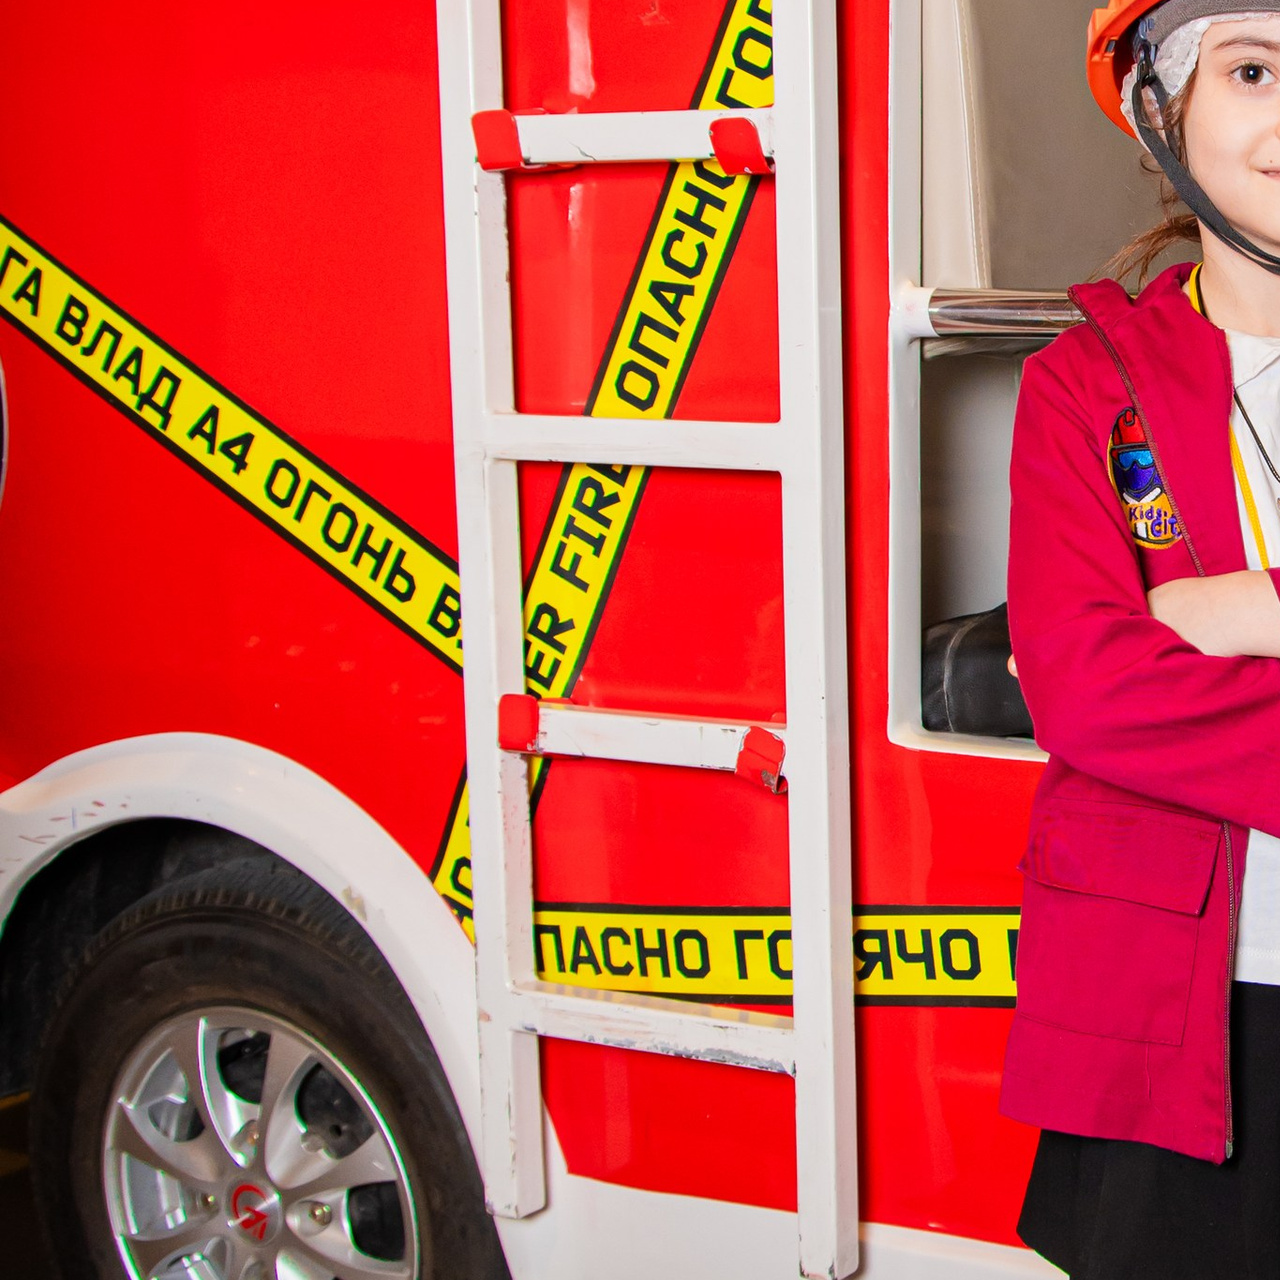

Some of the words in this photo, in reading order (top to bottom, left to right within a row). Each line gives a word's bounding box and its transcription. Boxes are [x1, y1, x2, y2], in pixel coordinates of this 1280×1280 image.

[54, 293, 183, 432] ВЛАД
[186, 403, 255, 477] А4
[263, 457, 417, 603] ОГОНЬ
[534, 924, 711, 980] ПАСНО
[733, 928, 982, 981] ГОЯЧО
